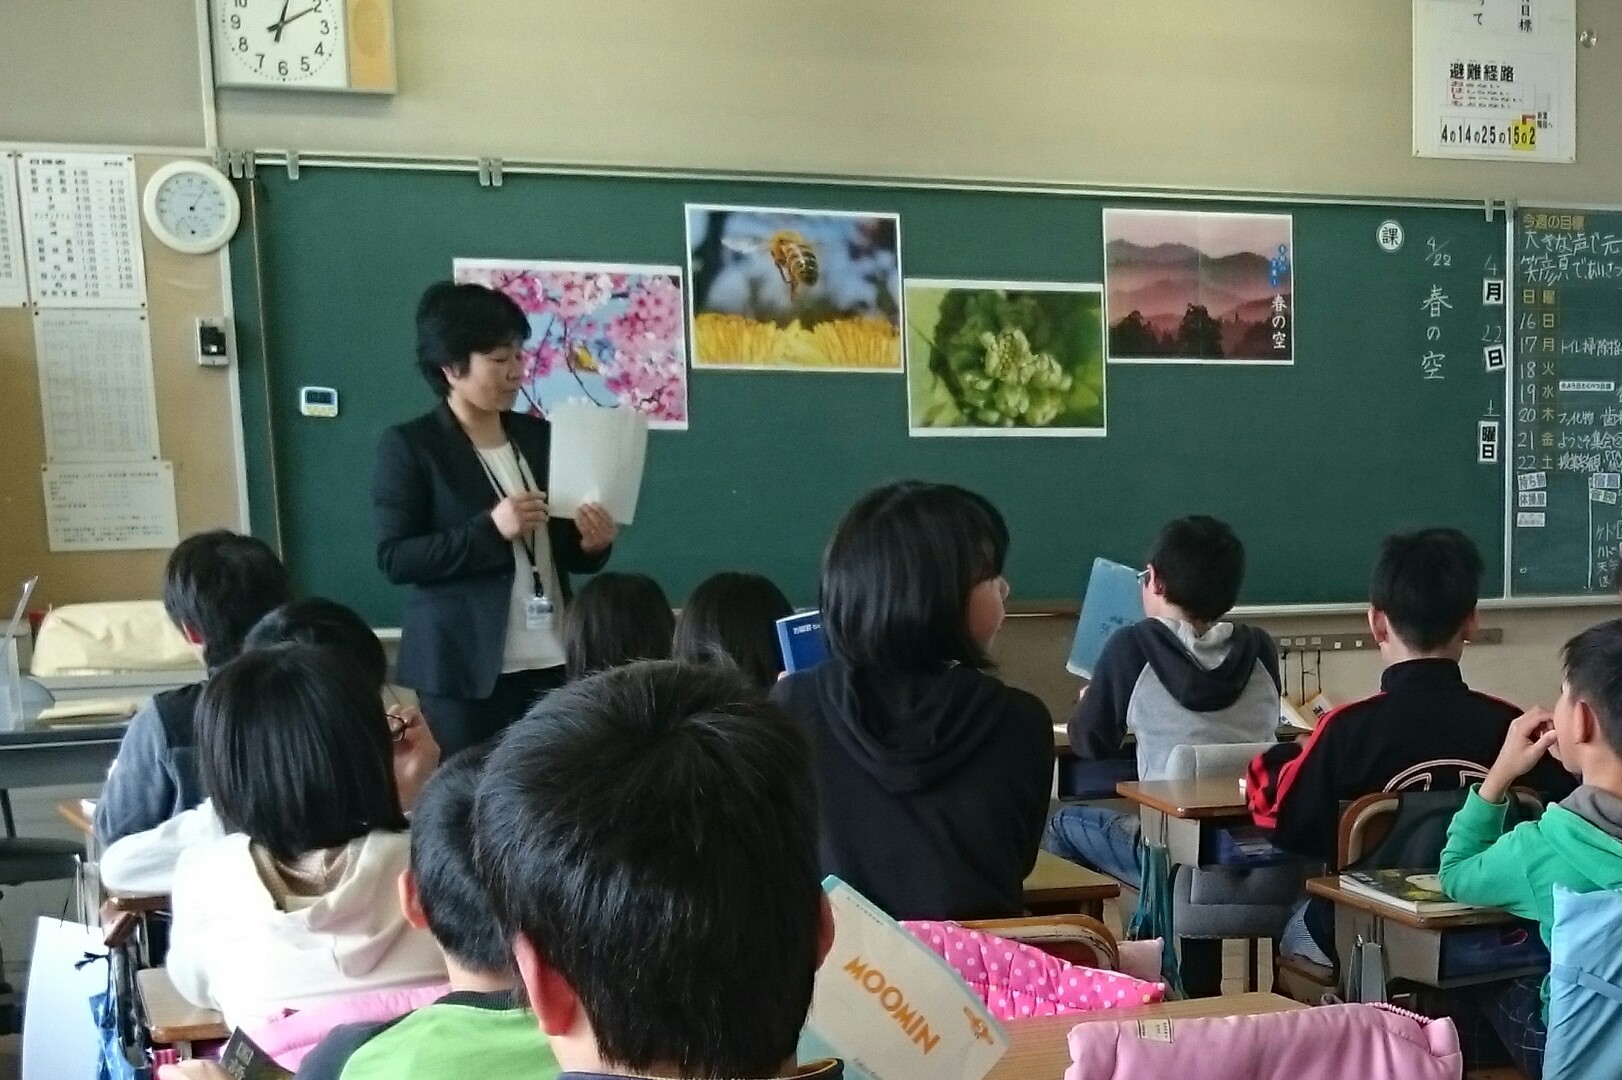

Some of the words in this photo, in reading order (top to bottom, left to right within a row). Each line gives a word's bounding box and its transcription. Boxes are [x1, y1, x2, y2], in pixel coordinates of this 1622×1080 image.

[230, 14, 241, 30] 9
[320, 20, 330, 35] 3
[238, 37, 249, 52] 8
[314, 42, 325, 57] 4
[255, 54, 265, 69] 7
[278, 61, 288, 76] 6
[300, 57, 310, 72] 5
[1450, 63, 1514, 82] 避難経路
[1382, 227, 1400, 246] 課
[1271, 293, 1288, 349] 春の空
[1520, 313, 1536, 330] 16
[1421, 284, 1453, 380] 春の空
[1520, 336, 1537, 353] 17
[1520, 362, 1536, 379] 18
[1520, 384, 1536, 404] 19
[1518, 407, 1536, 423] 20
[1482, 426, 1496, 459] 曜日
[1517, 431, 1534, 450] 21
[1518, 456, 1536, 470] 22
[843, 956, 941, 1055] MOOMIN
